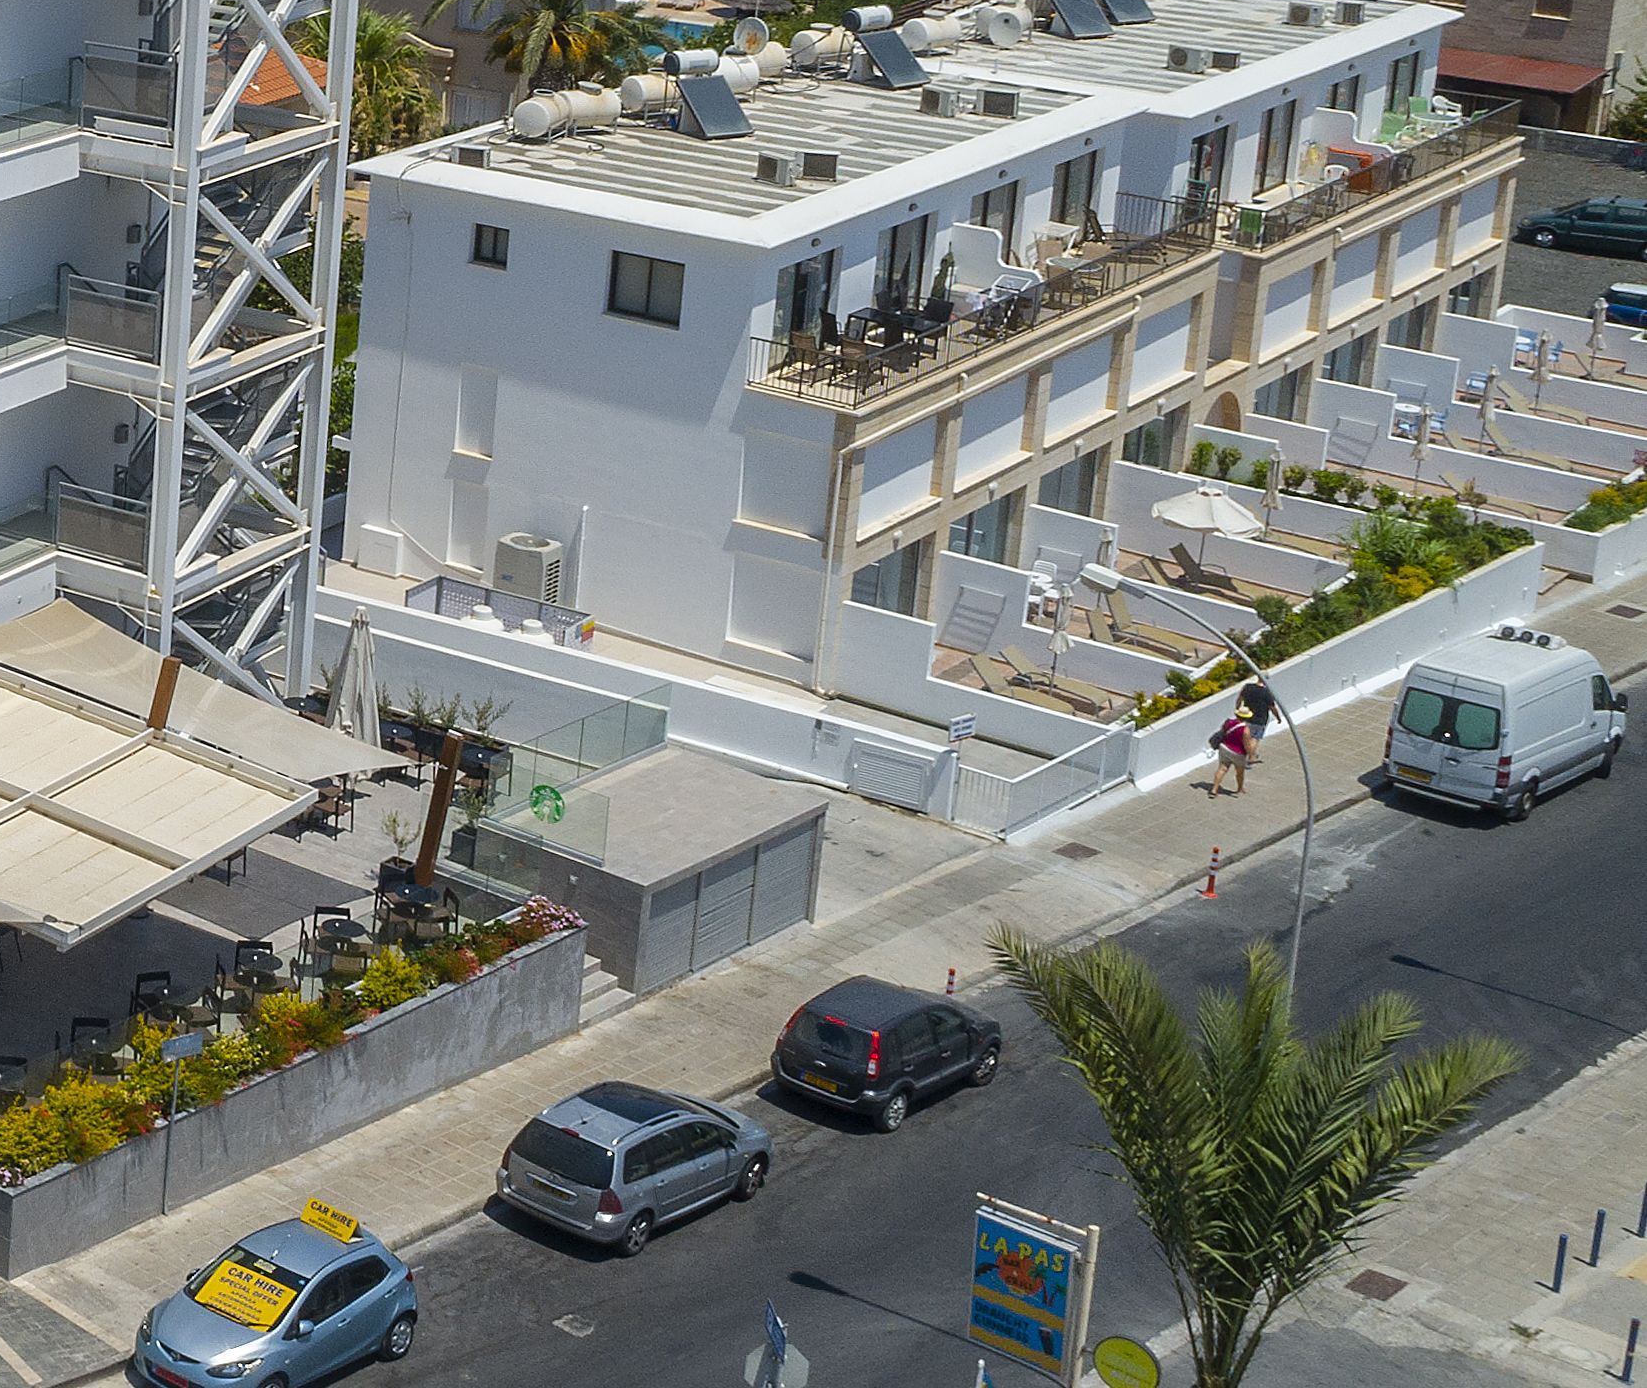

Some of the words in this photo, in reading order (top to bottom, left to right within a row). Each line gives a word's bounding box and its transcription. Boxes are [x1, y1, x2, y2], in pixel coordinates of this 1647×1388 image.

[310, 1200, 329, 1217] CAR
[330, 1210, 354, 1228] HIRE
[979, 1232, 1008, 1255] LA
[219, 1276, 250, 1294] SPECIAL
[227, 1267, 253, 1285] CAR
[255, 1278, 285, 1298] HIRE
